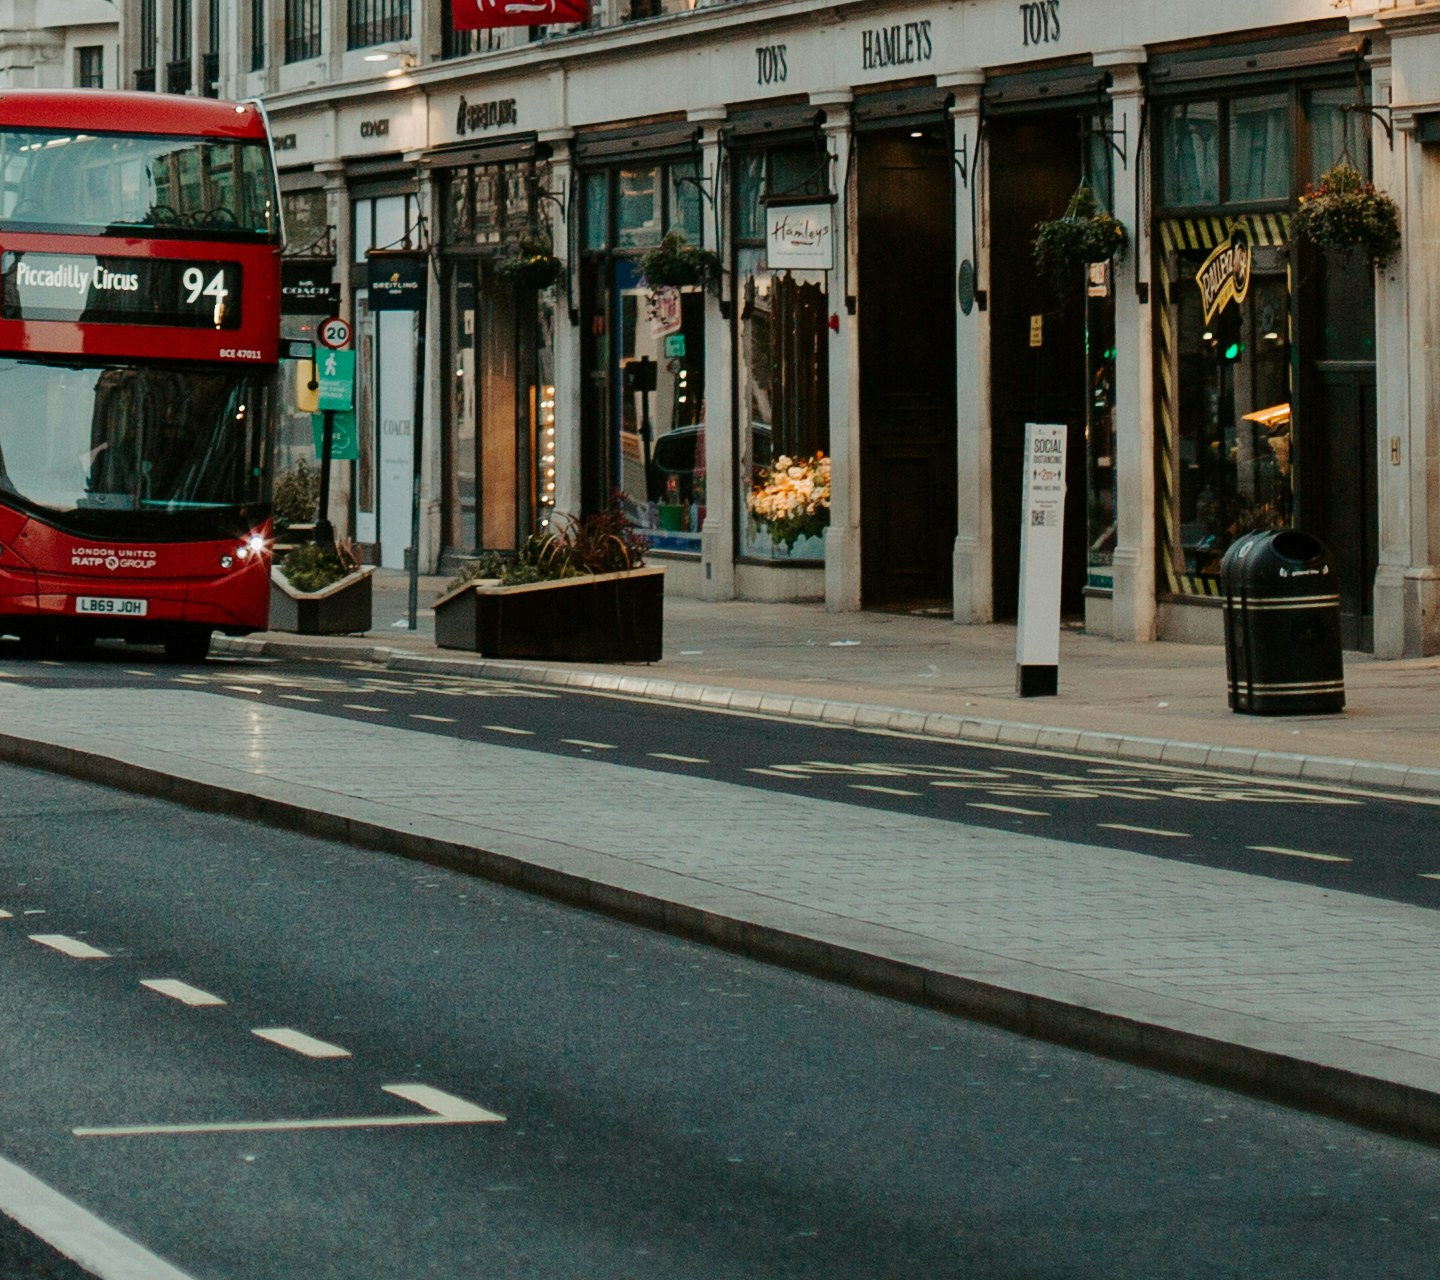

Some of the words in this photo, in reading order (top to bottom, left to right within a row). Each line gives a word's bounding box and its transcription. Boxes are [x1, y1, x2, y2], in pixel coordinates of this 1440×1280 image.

[861, 20, 932, 71] HAMLEYS
[755, 43, 788, 85] TOYS
[360, 119, 389, 137] COACH
[271, 134, 296, 151] OACH
[770, 215, 829, 248] Hamleys
[16, 262, 89, 294] Piccadilly
[93, 266, 139, 291] Circus
[182, 267, 229, 306] 94
[282, 286, 330, 295] COACH
[372, 281, 419, 289] BREITLING
[326, 327, 347, 340] 20
[219, 349, 236, 359] BCE
[237, 349, 262, 360] 47011
[383, 419, 412, 436] COACH
[1034, 439, 1062, 453] SOCIAL
[1033, 455, 1063, 464] DISTANCING
[72, 547, 115, 556] LONDON
[118, 549, 157, 558] UNITED
[71, 556, 104, 566] RATP
[120, 558, 157, 569] GROUP
[81, 599, 114, 612] LB69
[117, 600, 141, 613] JOH
